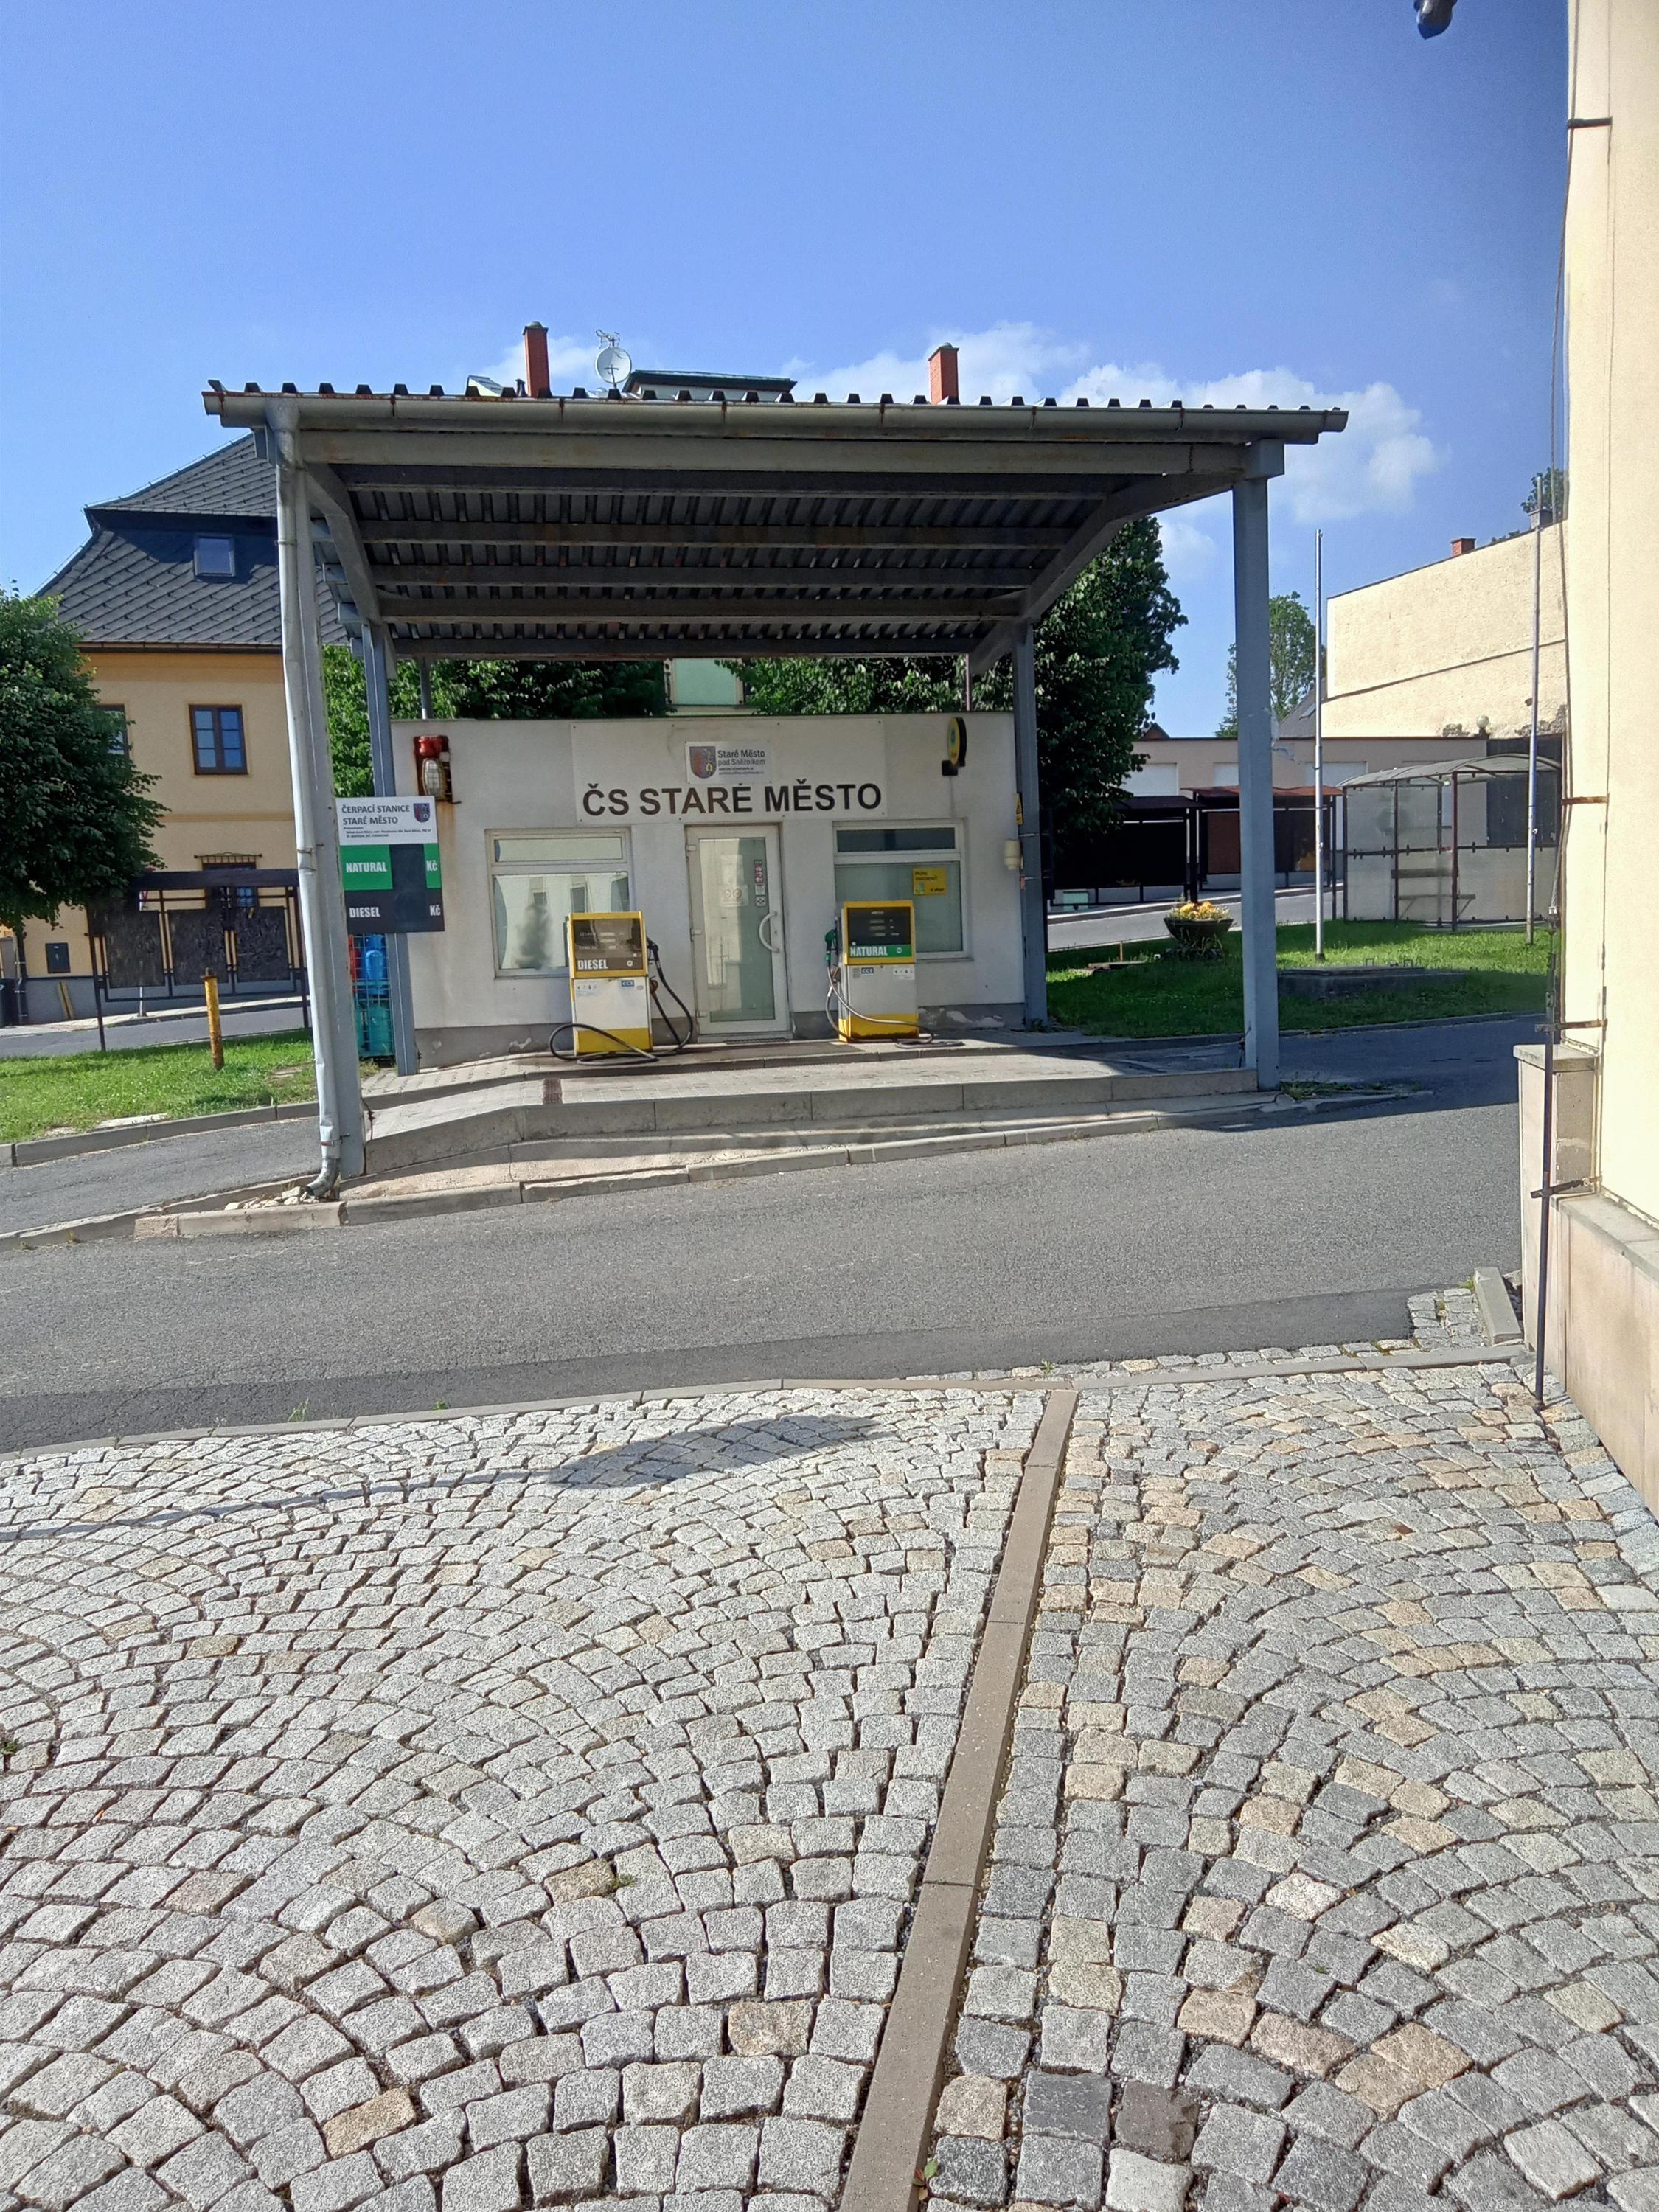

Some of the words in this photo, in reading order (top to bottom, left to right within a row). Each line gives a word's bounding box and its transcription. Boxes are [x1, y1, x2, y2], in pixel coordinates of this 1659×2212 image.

[717, 749, 739, 758] Staré
[740, 749, 765, 758] Město
[717, 759, 730, 767] pod
[582, 783, 630, 816] ČS
[639, 783, 753, 815] STARÉ
[765, 779, 882, 812] MĚSTO
[341, 804, 375, 813] ČERPACÍ
[377, 804, 410, 813] STANICE
[343, 815, 367, 825] STARÉ
[369, 815, 398, 824] MĚSTO
[346, 861, 387, 873] NATURAL
[426, 860, 437, 871] Kč
[349, 907, 380, 918] DIESEL
[430, 905, 441, 916] Kč
[849, 946, 888, 956] NATURAL
[577, 959, 608, 970] DIESEL
